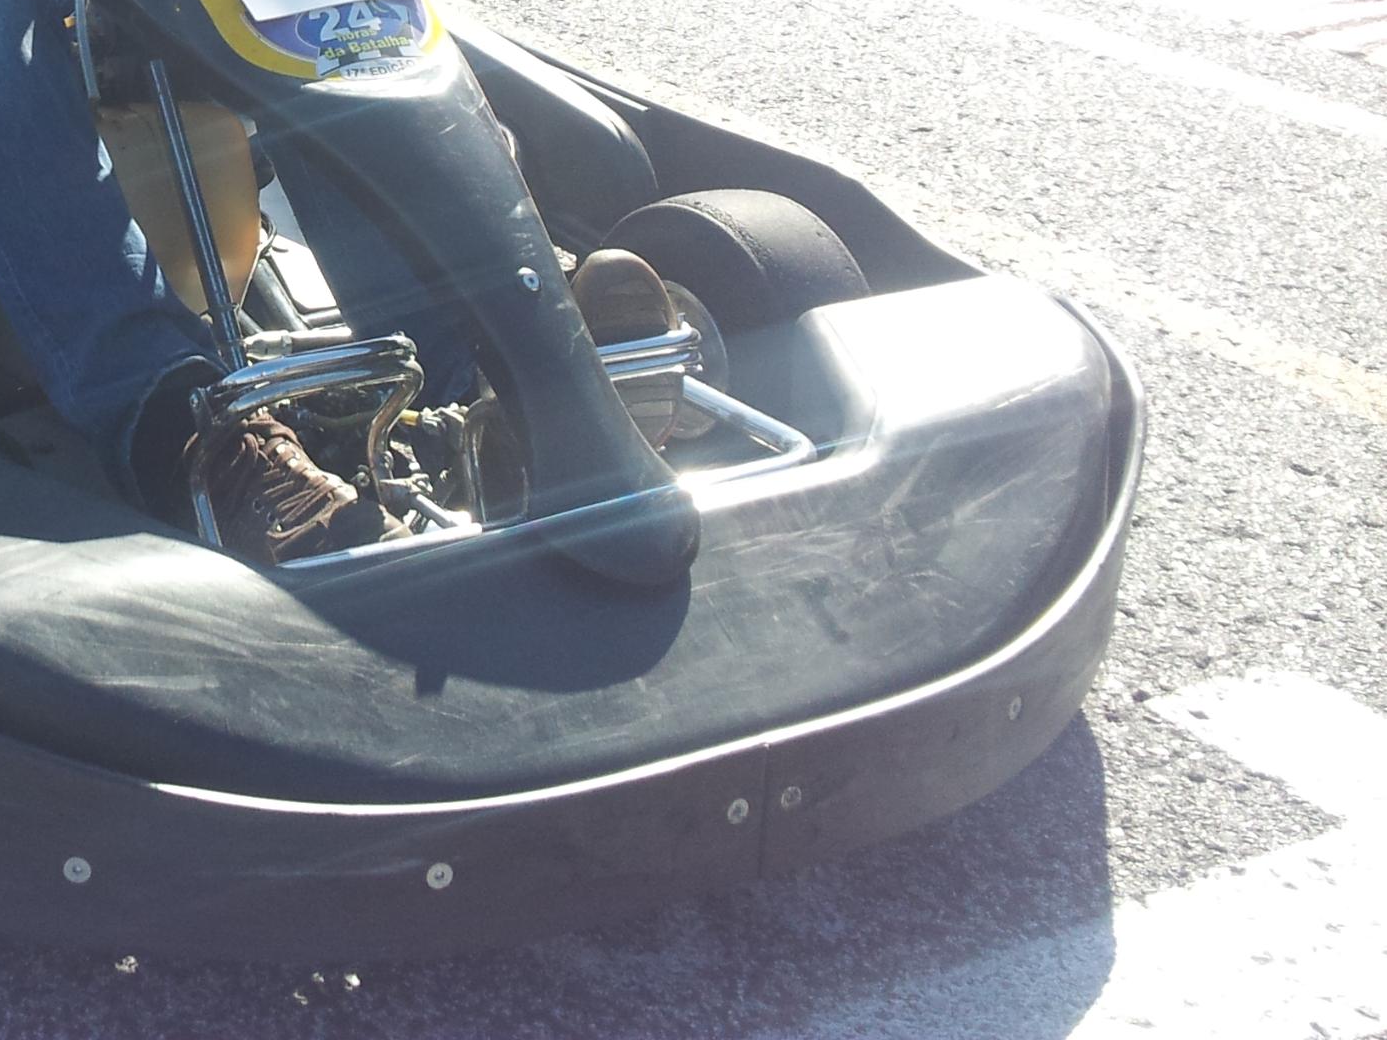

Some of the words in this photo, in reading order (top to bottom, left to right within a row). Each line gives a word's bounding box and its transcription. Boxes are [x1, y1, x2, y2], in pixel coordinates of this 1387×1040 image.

[309, 0, 382, 42] 24
[337, 27, 378, 42] horas
[324, 48, 345, 60] da
[348, 35, 409, 54] Batalha
